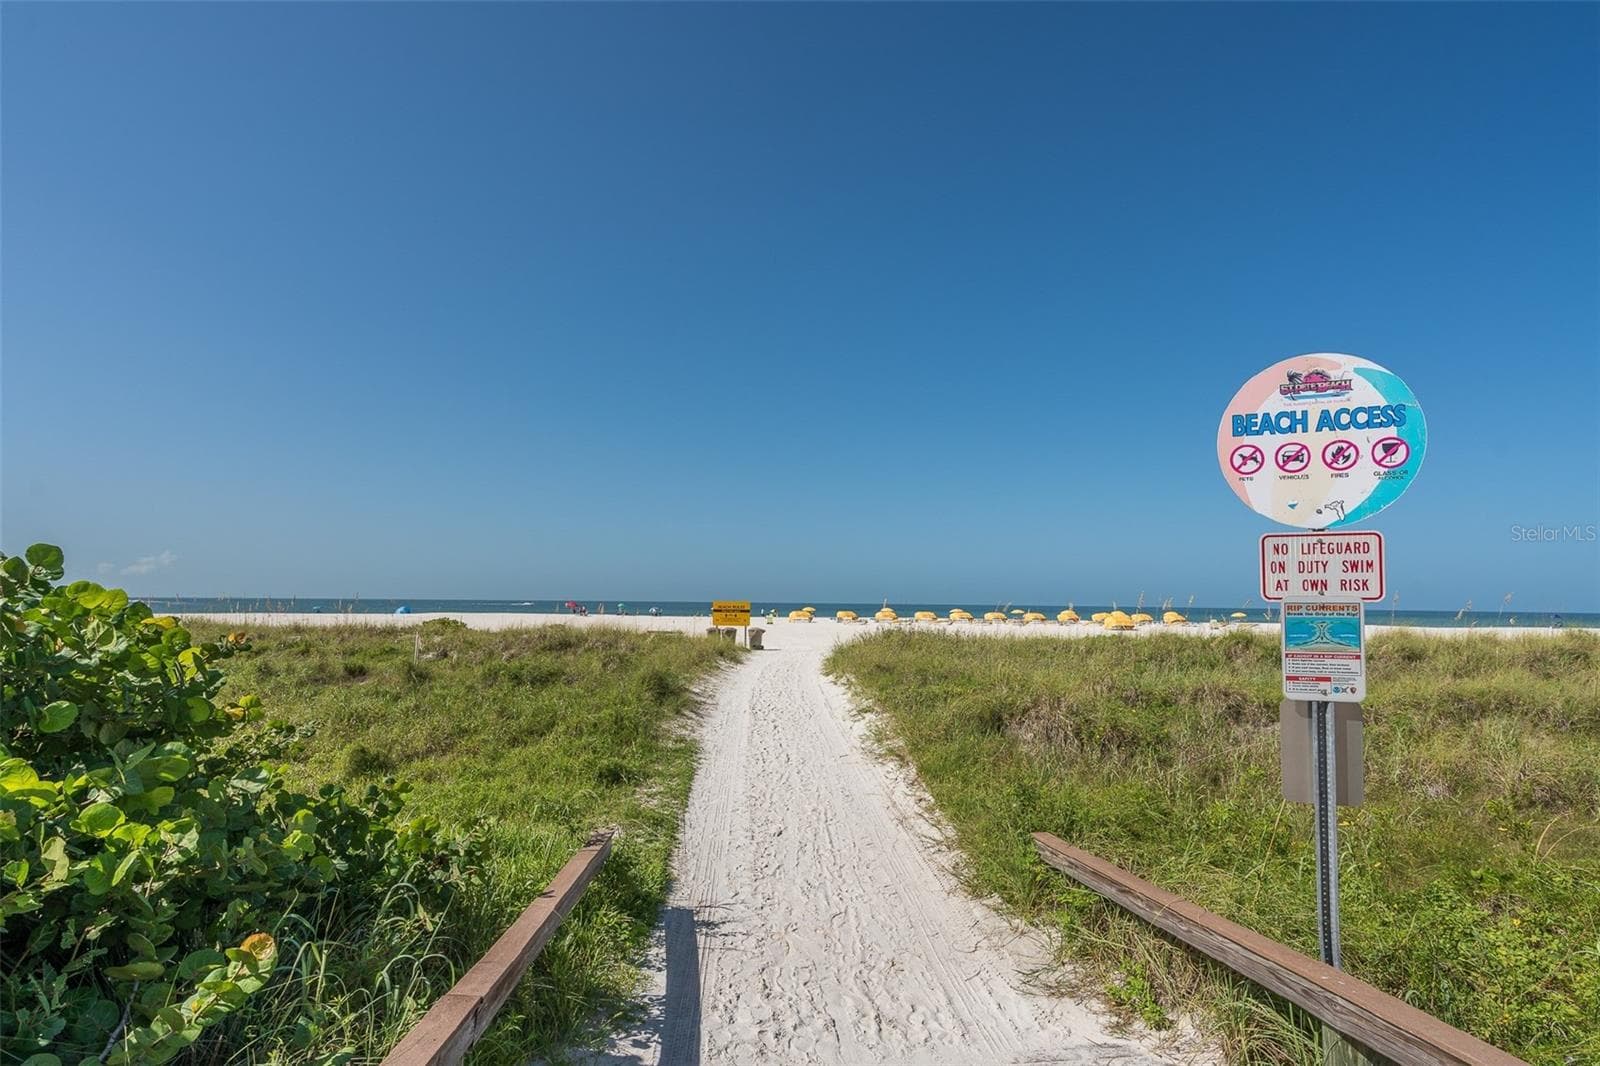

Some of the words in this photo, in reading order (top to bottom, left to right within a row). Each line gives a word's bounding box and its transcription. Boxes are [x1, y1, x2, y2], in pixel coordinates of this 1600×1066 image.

[1231, 410, 1309, 437] BEACH
[1315, 403, 1407, 433] ACCESS
[1273, 543, 1289, 555] NO
[1301, 542, 1370, 555] LIFEGUARD
[1270, 561, 1286, 574] ON
[1298, 561, 1329, 574] DUTY
[1342, 560, 1374, 573] SWIM
[1275, 580, 1290, 592] AT
[1302, 579, 1328, 592] OWN
[1340, 579, 1370, 591] RISK
